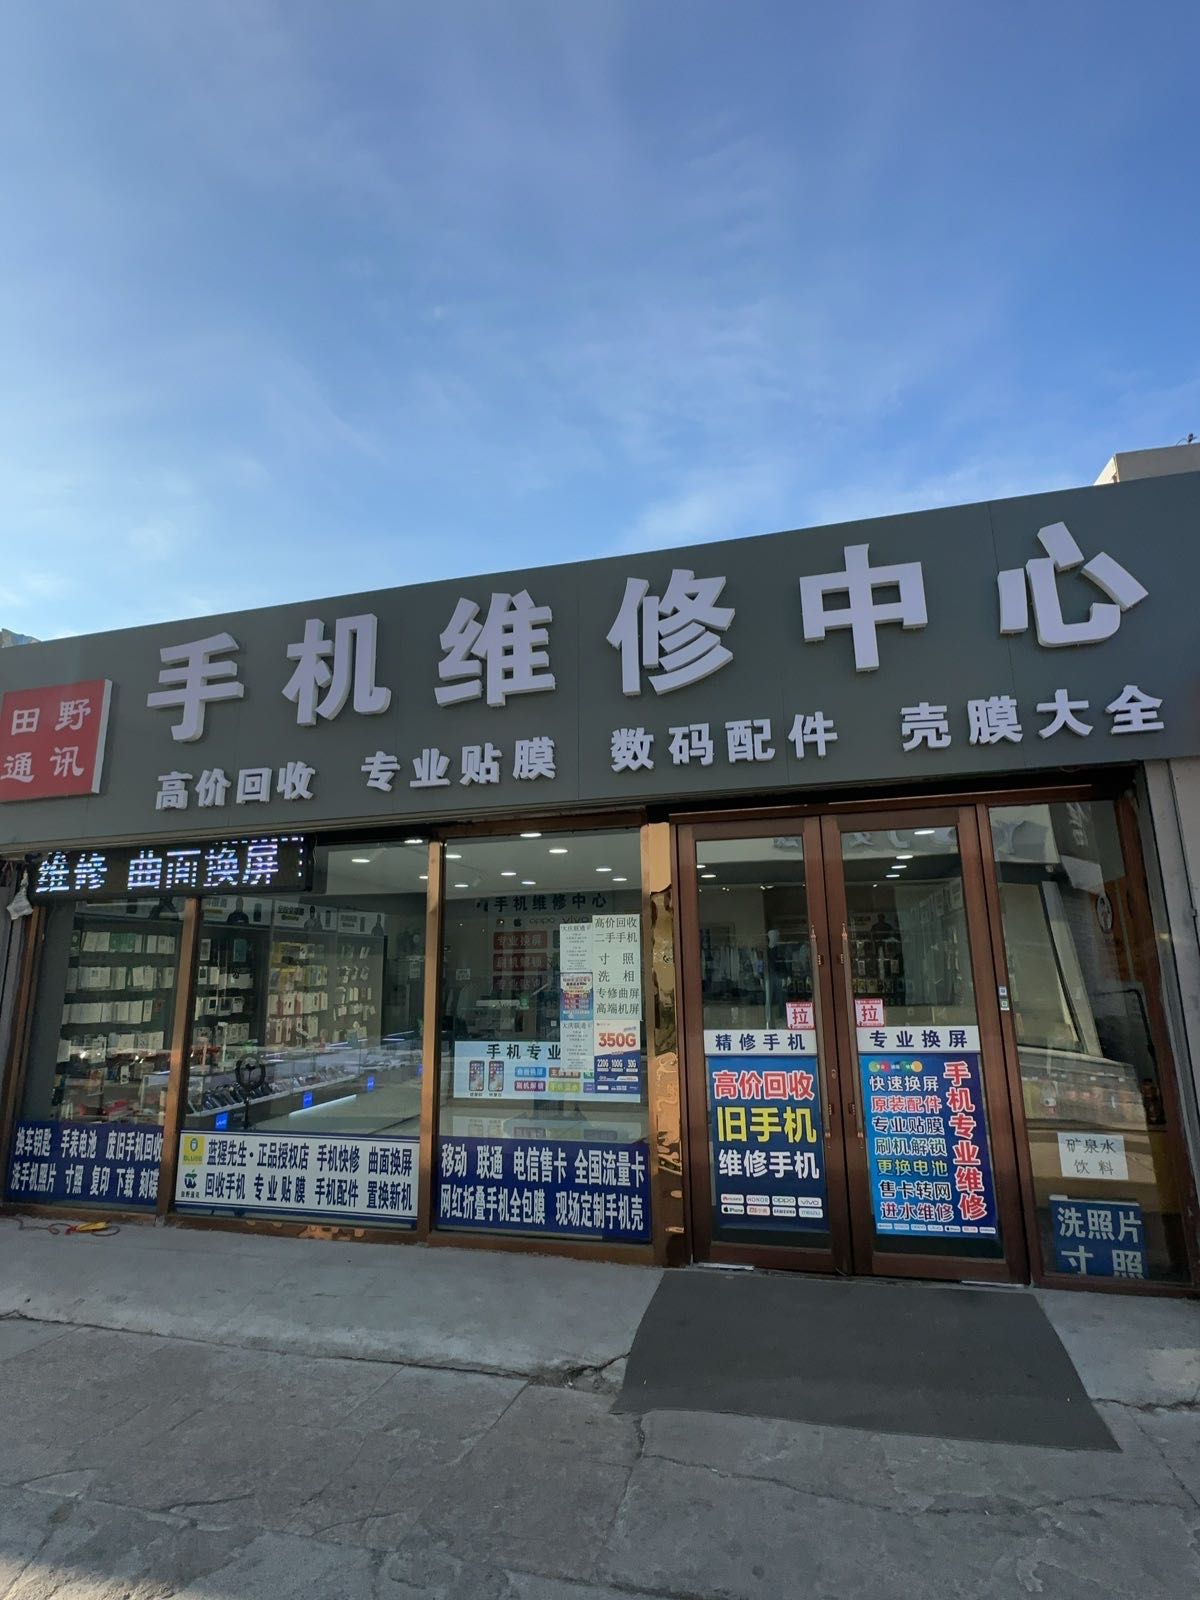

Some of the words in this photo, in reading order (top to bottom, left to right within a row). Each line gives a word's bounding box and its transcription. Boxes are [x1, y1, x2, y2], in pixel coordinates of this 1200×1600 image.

[147, 522, 1148, 742] 手机维修中心
[11, 699, 91, 736] 田野
[155, 761, 315, 810] 高价回收
[361, 736, 556, 792] 专业贴膜
[610, 711, 838, 773] 数码配件
[901, 685, 1164, 751] 壳膜大全
[1, 747, 85, 783] 通讯
[494, 893, 608, 912] 手机维修中心
[595, 917, 637, 928] 高价回收
[595, 932, 637, 943] 二手手机
[599, 952, 635, 965] 寸照
[598, 970, 635, 982] 洗相
[597, 988, 639, 999] 专修曲屏
[596, 1003, 639, 1015] 高端机屏
[792, 1009, 808, 1025] 拉
[861, 1006, 878, 1022] 拉
[598, 1033, 637, 1047] 350G
[716, 1033, 805, 1051] 精修手机
[869, 1030, 967, 1048] 专业换屏
[487, 1044, 560, 1060] 手机专业
[713, 1070, 814, 1100] 高价回收
[869, 1075, 939, 1092] 快速换屏
[871, 1095, 942, 1114] 原装配件
[717, 1106, 816, 1143] 旧手机
[872, 1116, 944, 1135] 专业贴膜
[60, 1128, 97, 1158] 手表电池
[105, 1130, 163, 1162] 废旧手机回收
[875, 1138, 947, 1156] 刷机解锁
[943, 1061, 987, 1221] 手机专业维修
[1065, 1138, 1116, 1154] 矿泉水
[316, 1144, 360, 1174] 手机快修
[368, 1146, 412, 1177] 曲面换屏
[441, 1143, 467, 1177] 移动
[476, 1145, 503, 1179] 联通
[513, 1146, 567, 1184] 电信售卡
[574, 1149, 645, 1187] 全国流量卡
[718, 1149, 819, 1179] 维修手机
[877, 1159, 949, 1177] 更换电池
[1073, 1159, 1114, 1175] 饮料
[90, 1165, 110, 1196] 复印
[116, 1166, 135, 1198] 下载
[879, 1180, 952, 1200] 售卡转网
[205, 1172, 246, 1200] 回收手机
[253, 1173, 305, 1204] 专业贴膜
[314, 1177, 358, 1208] 手机配件
[366, 1181, 412, 1211] 置换新机
[440, 1184, 546, 1225] 网红折叠手机全包膜
[555, 1190, 644, 1231] 现场定制手机壳
[880, 1202, 954, 1222] 进水维修
[1058, 1207, 1142, 1243] 洗照片
[1061, 1245, 1144, 1279] 寸照
